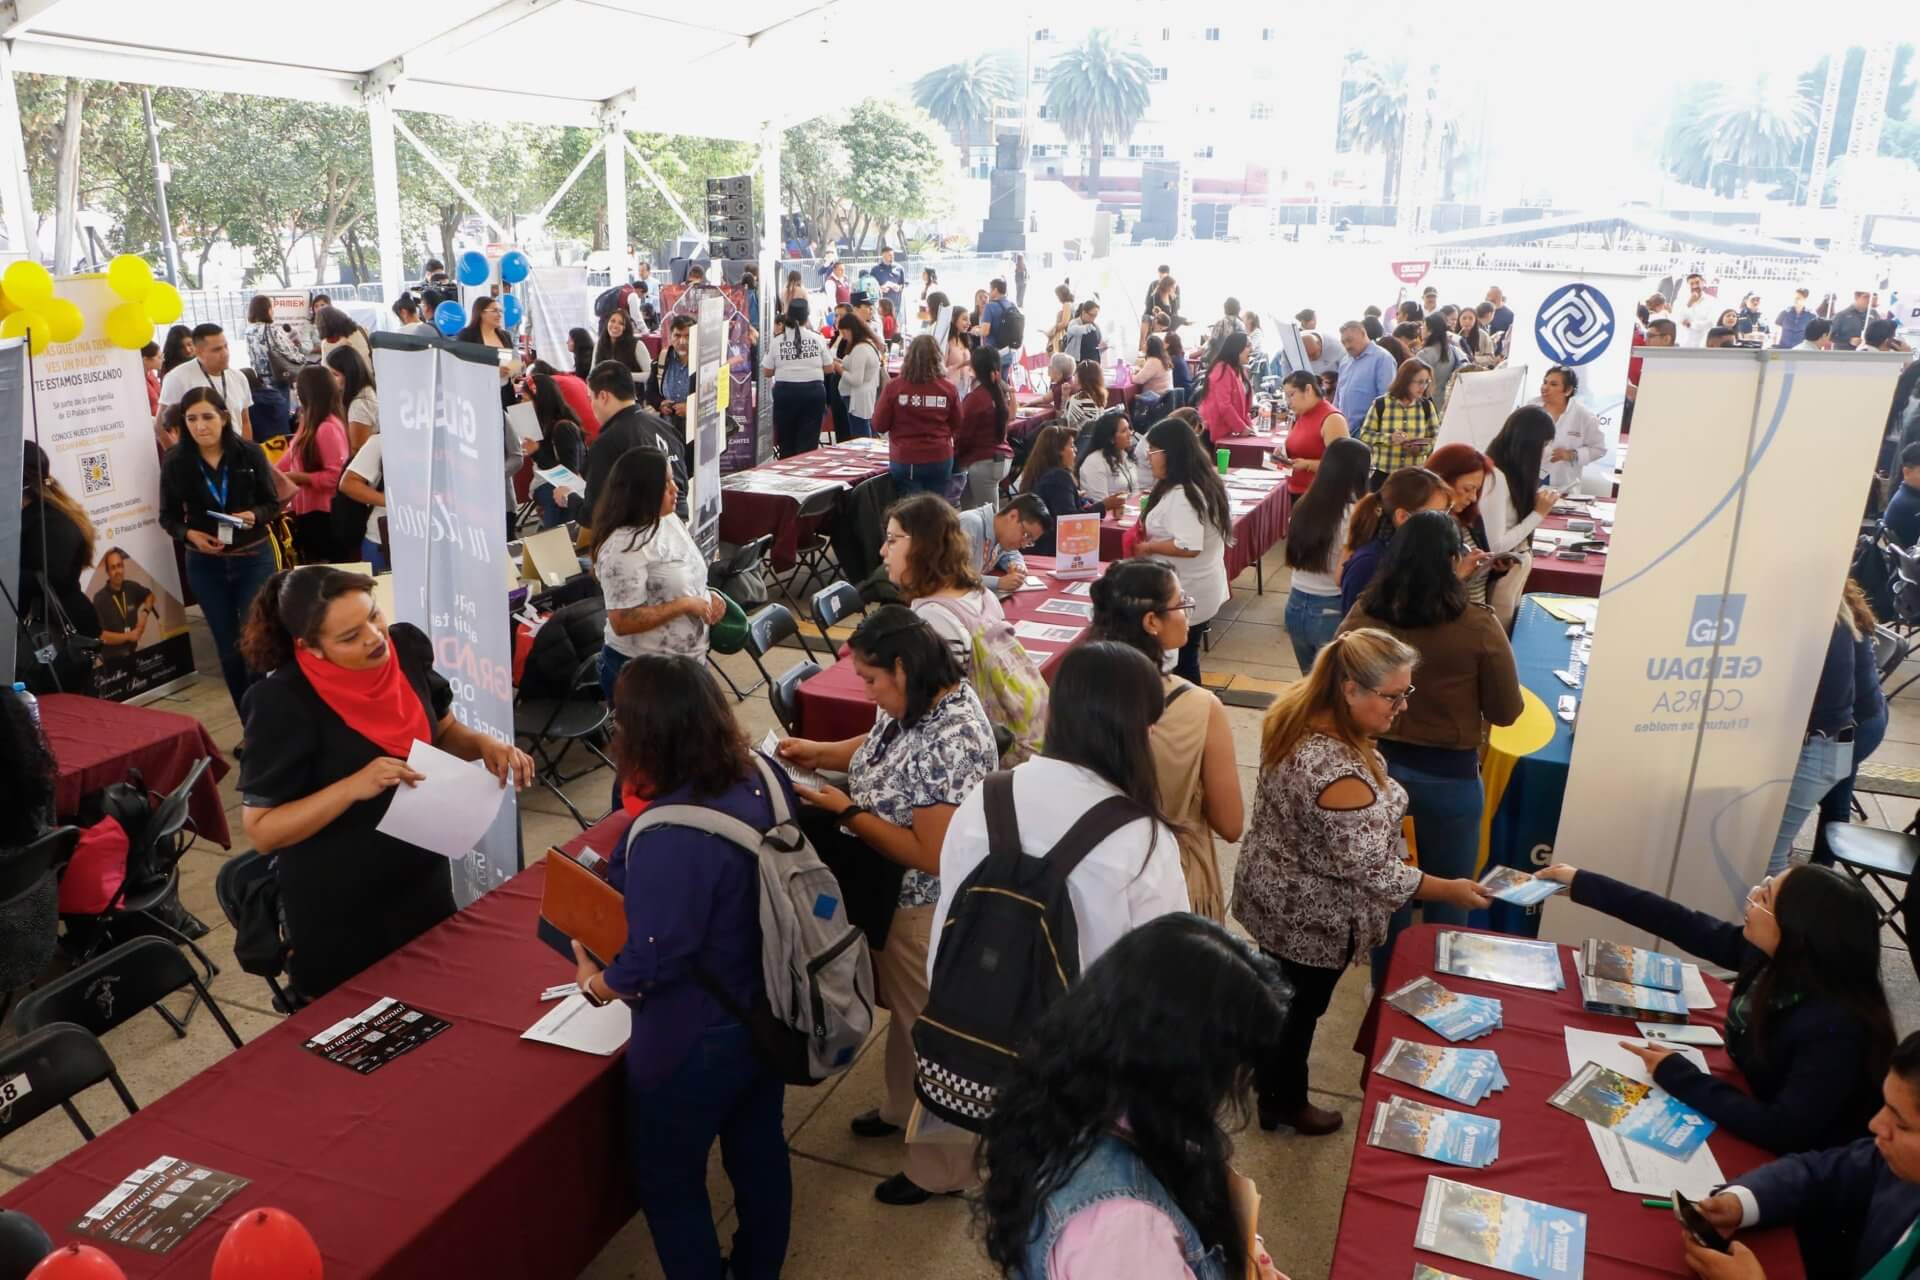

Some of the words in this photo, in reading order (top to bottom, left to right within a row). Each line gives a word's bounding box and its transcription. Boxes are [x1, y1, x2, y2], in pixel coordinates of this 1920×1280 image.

[779, 338, 818, 348] POLCIA
[780, 351, 819, 361] FEDERAL
[35, 380, 46, 392] TE
[47, 374, 83, 391] ESTAMOS
[83, 367, 123, 384] BUSCANDO
[335, 1024, 368, 1047] talento!
[115, 1186, 152, 1220] talento!
